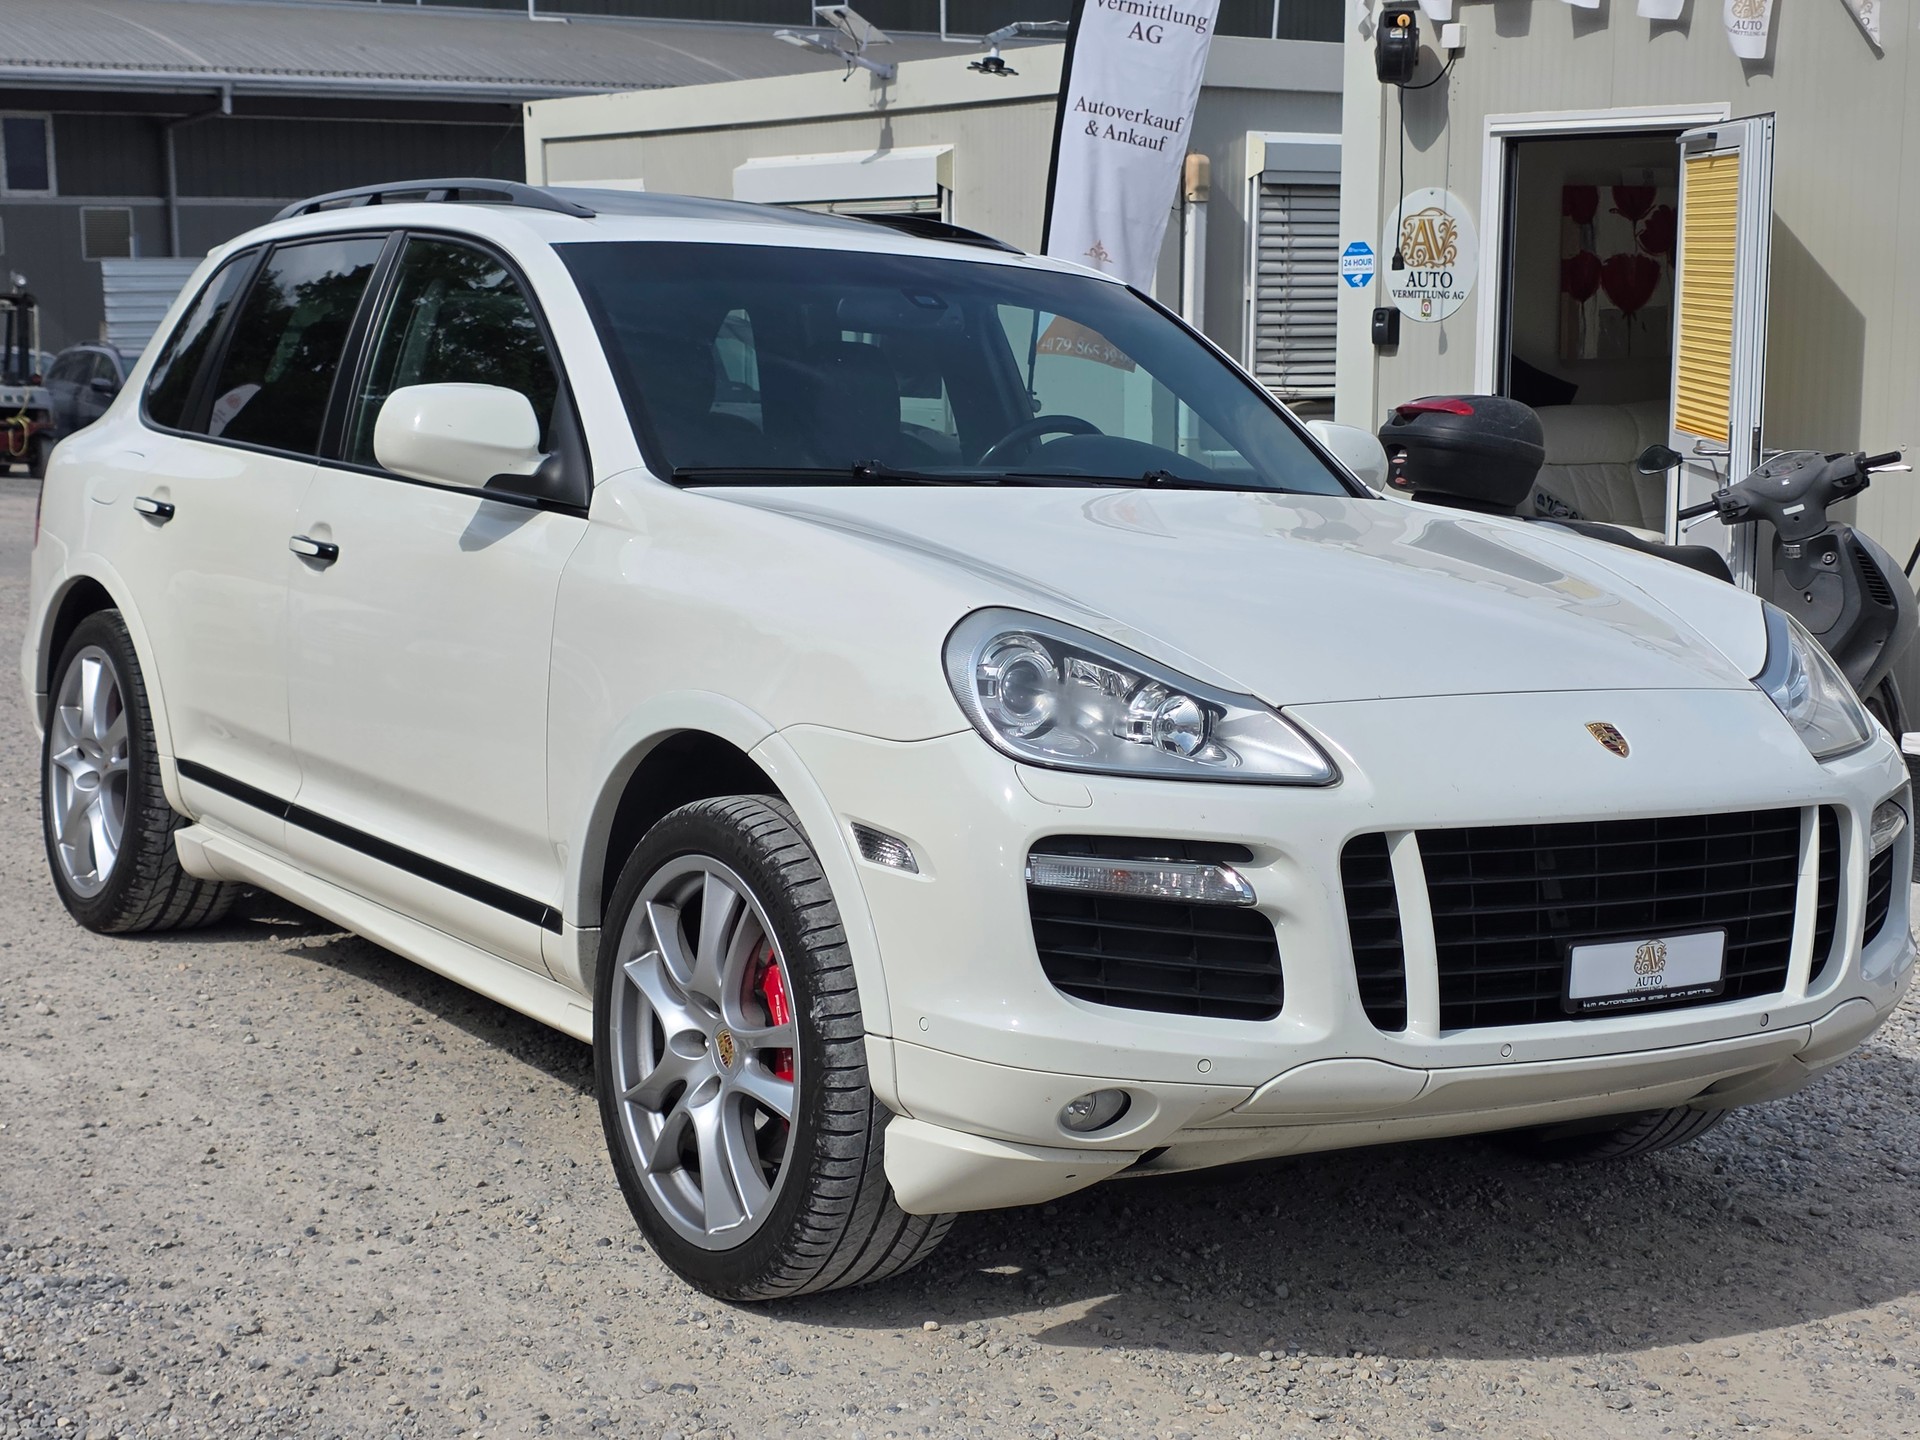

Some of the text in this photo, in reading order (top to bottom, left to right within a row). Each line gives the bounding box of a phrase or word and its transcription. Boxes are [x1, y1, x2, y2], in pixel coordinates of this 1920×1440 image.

[1127, 21, 1164, 44] AG
[1732, 20, 1763, 30] AUTO
[1074, 96, 1184, 133] Autoverkauf
[1084, 120, 1168, 152] & Ankauf
[1344, 258, 1373, 267] 24 HOUR
[1406, 271, 1453, 289] AUTO
[1392, 289, 1464, 300] VERMITTLUNG AG
[1055, 336, 1072, 352] 79
[1635, 975, 1662, 987] AUTO
